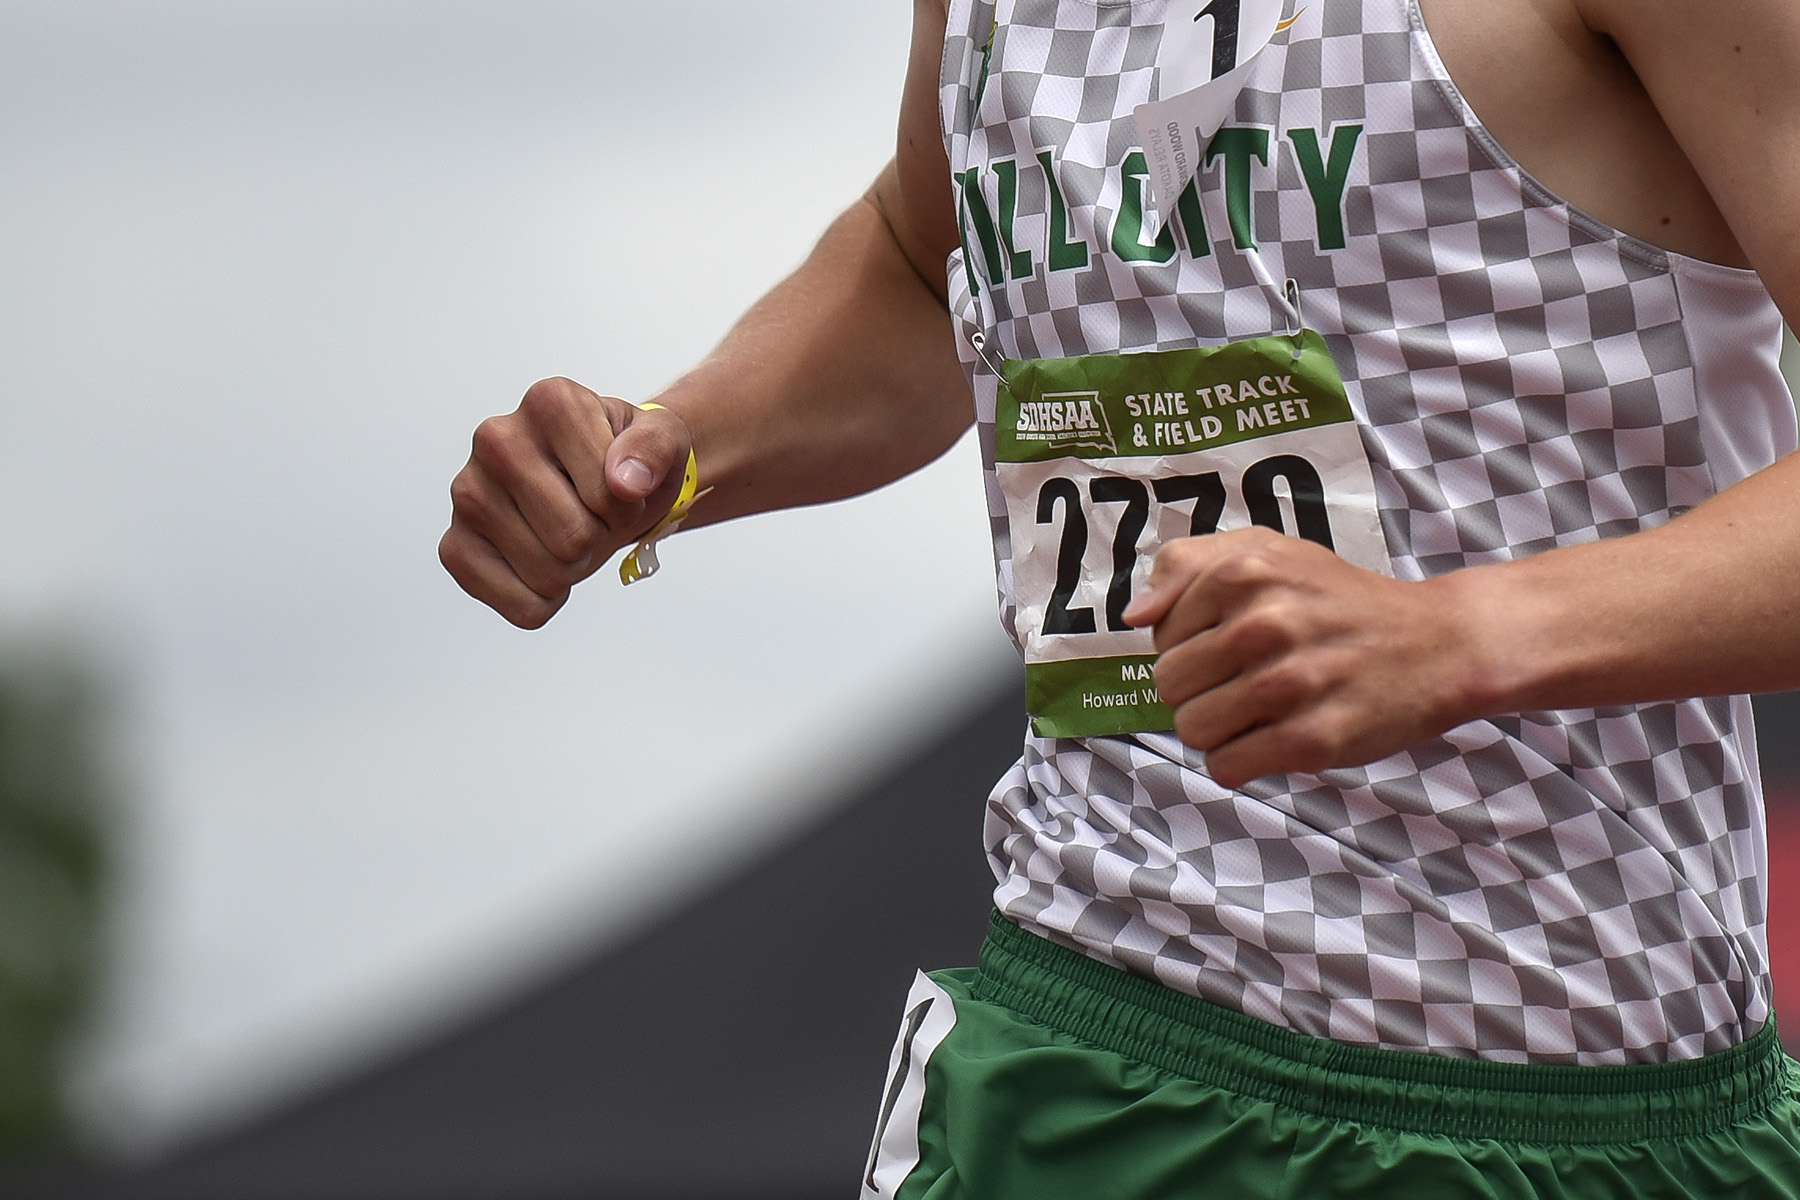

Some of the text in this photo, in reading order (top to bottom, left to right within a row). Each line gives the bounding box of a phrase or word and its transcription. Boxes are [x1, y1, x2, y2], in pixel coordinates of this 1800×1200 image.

[1124, 374, 1300, 417] STATE TRACK
[1016, 400, 1099, 431] SDHSAA
[1132, 398, 1312, 448] & FIELD MEET
[1082, 689, 1139, 709] Howard
